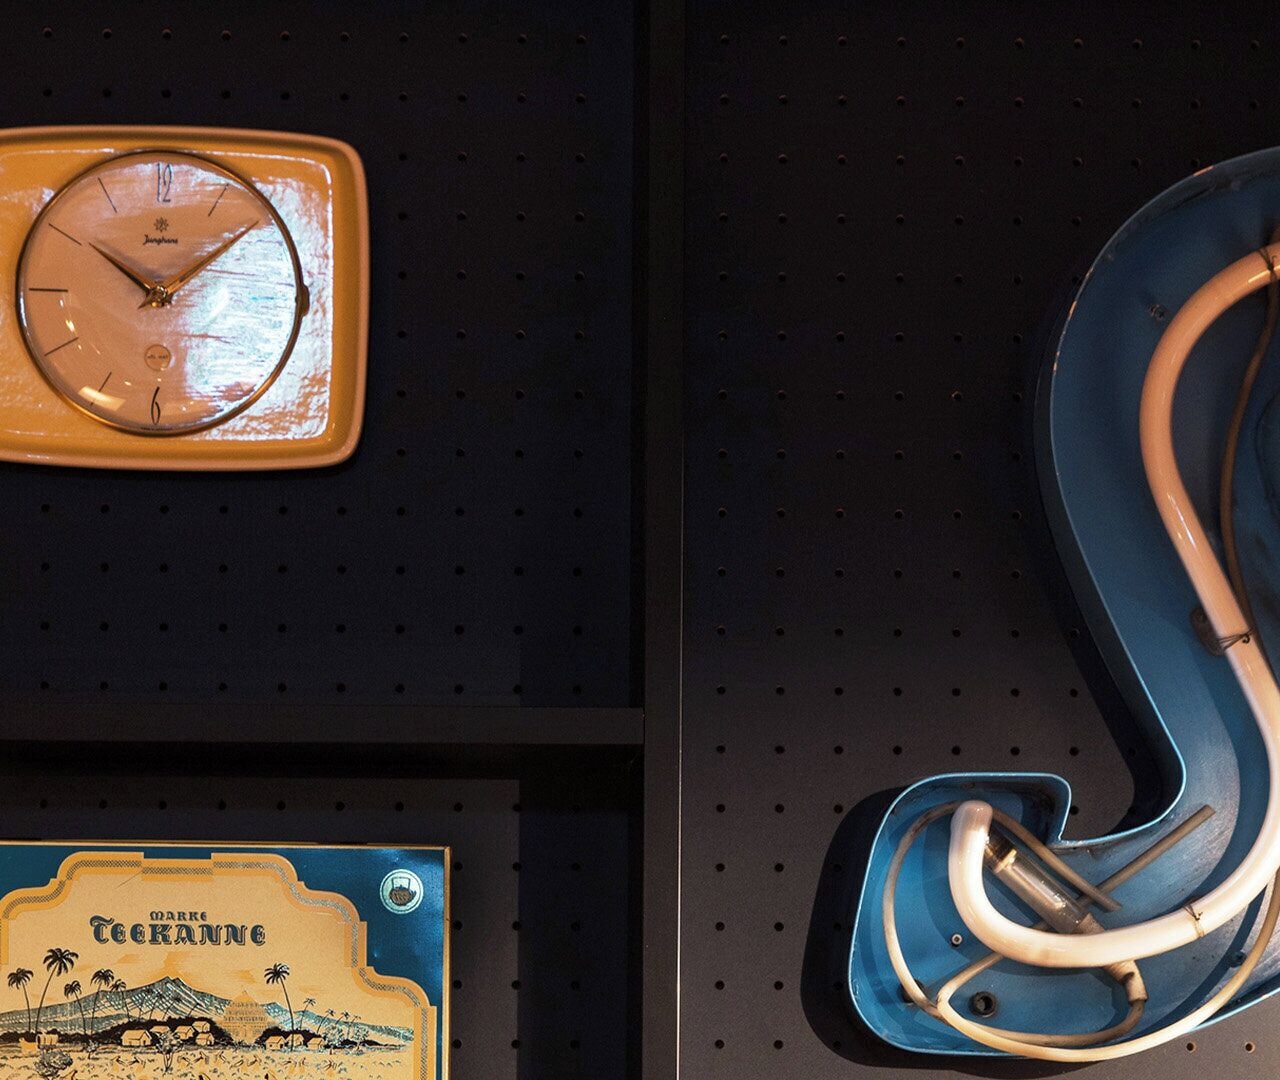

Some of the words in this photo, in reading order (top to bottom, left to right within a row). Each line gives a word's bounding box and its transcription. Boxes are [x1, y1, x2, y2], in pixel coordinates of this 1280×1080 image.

[155, 162, 174, 203] 12
[142, 233, 178, 246] Junghans
[150, 386, 161, 425] 6
[90, 914, 266, 947] TEEKANNE
[149, 910, 208, 923] MARKE
